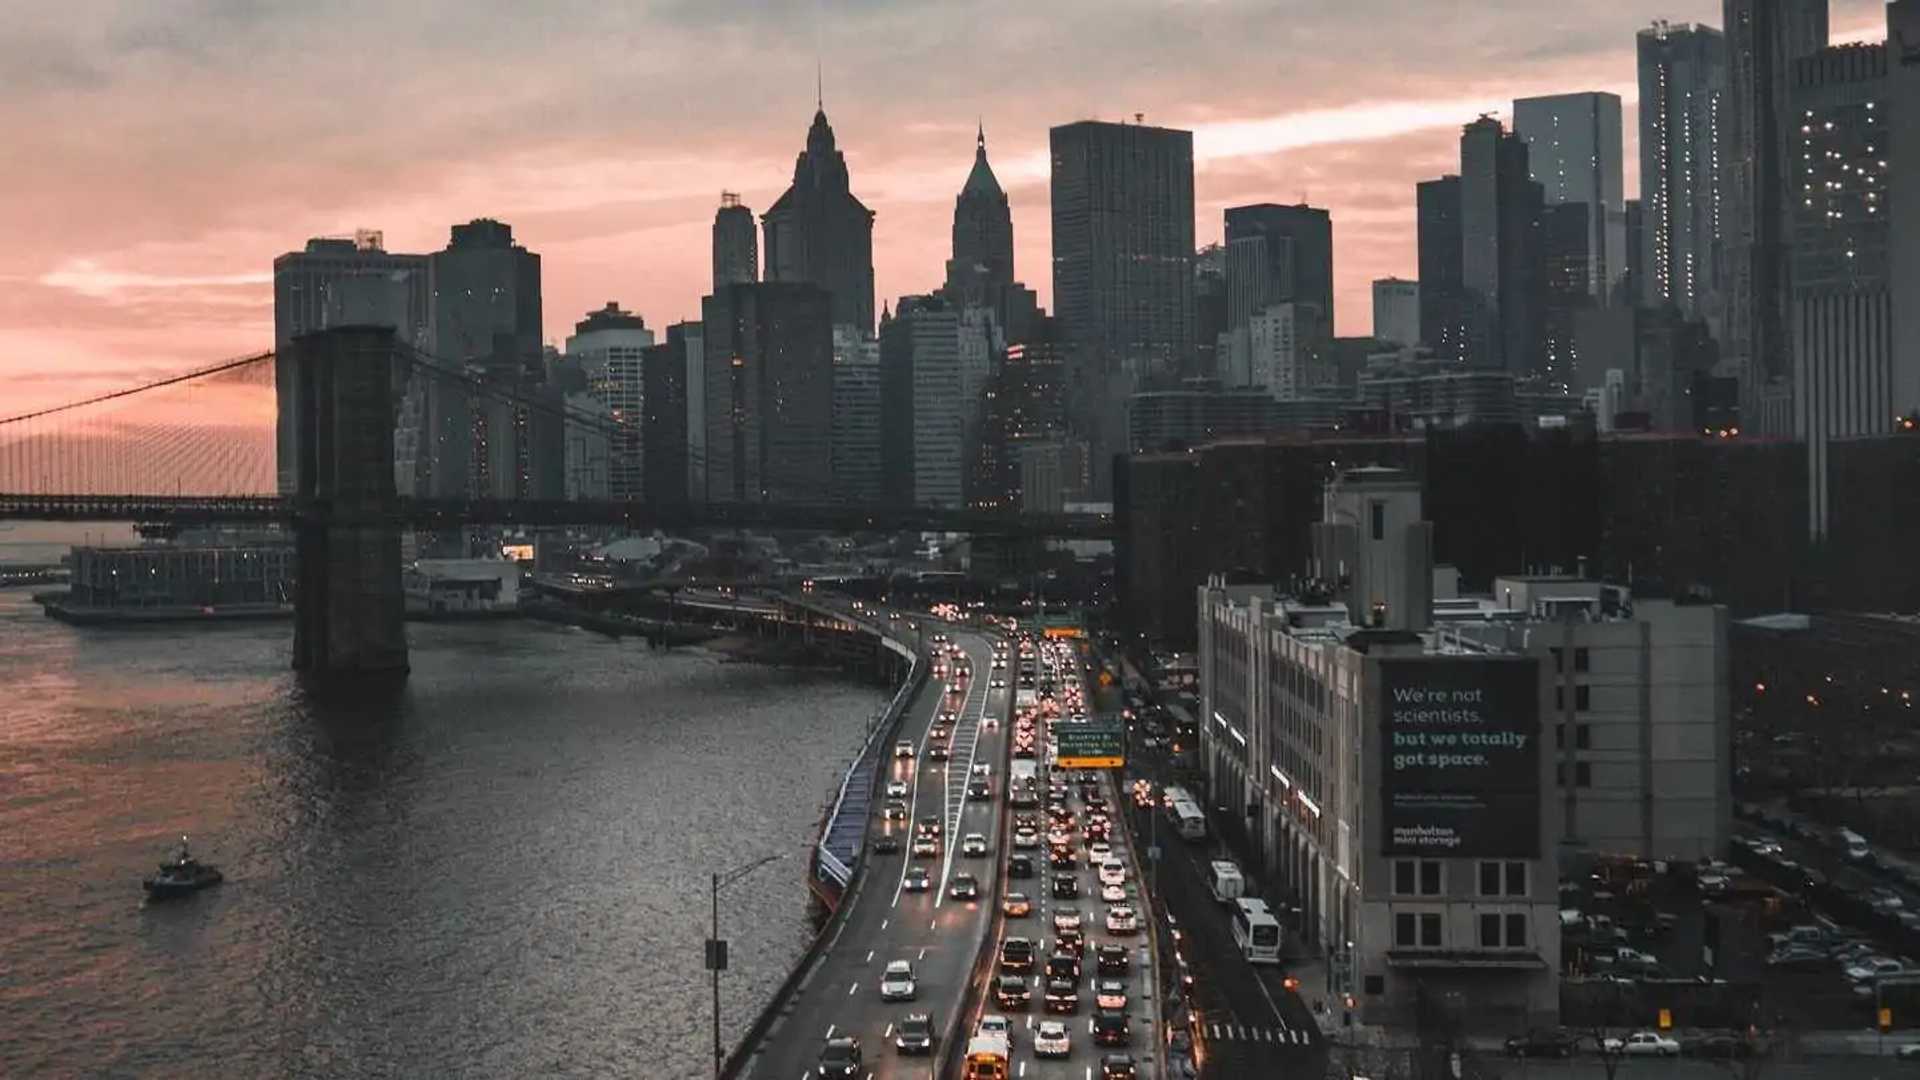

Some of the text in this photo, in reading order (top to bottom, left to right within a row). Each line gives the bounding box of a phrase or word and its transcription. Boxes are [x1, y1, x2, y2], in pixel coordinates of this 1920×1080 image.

[1393, 687, 1483, 703] We're not
[1393, 731, 1528, 749] but we totally
[1393, 753, 1488, 770] got space.
